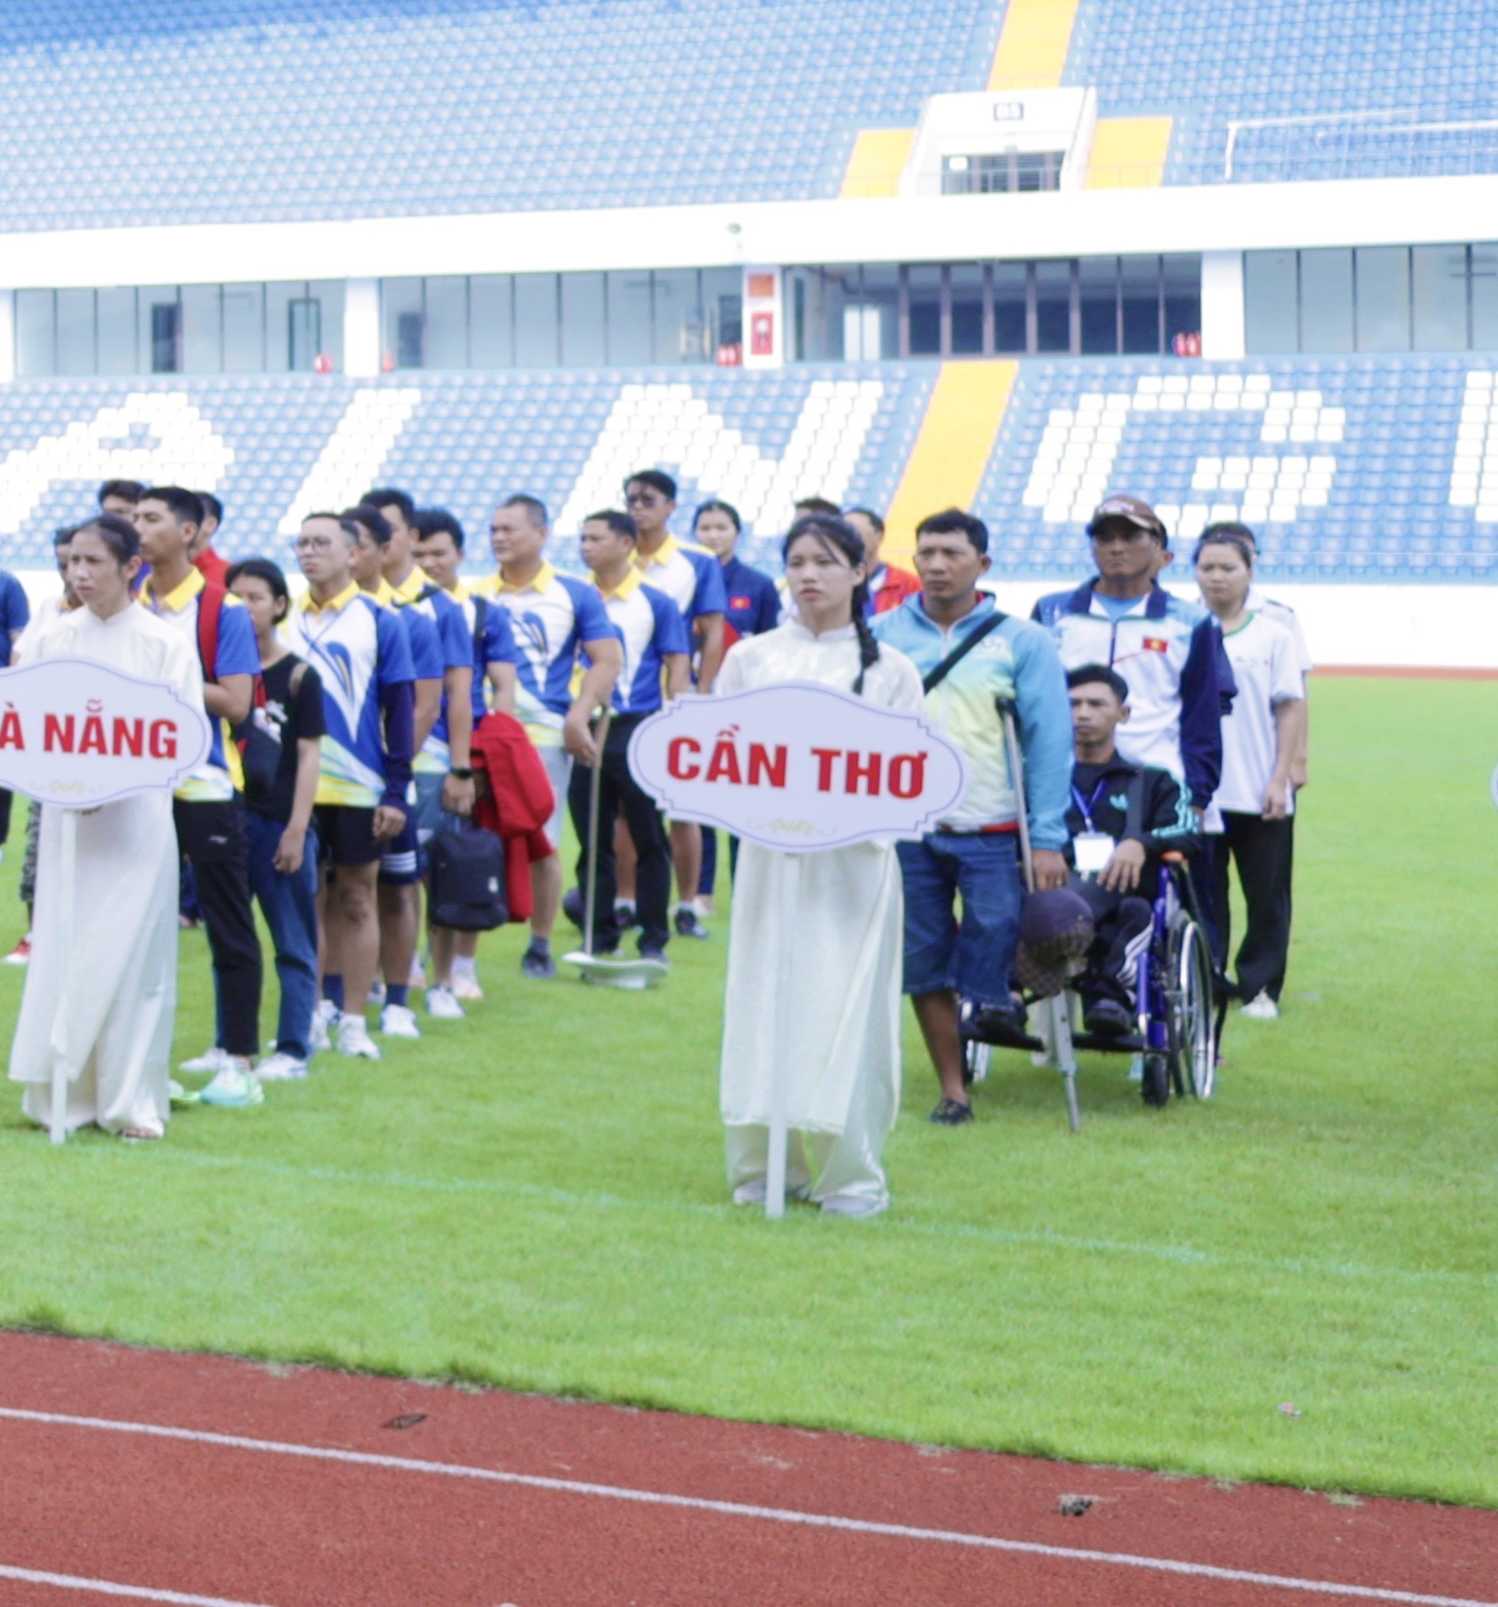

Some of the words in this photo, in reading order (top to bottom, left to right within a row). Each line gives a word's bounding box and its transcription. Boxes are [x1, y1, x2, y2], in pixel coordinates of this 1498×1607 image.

[43, 698, 178, 760] NẴNG
[667, 723, 788, 789] CẦN
[811, 748, 929, 800] THƠ
